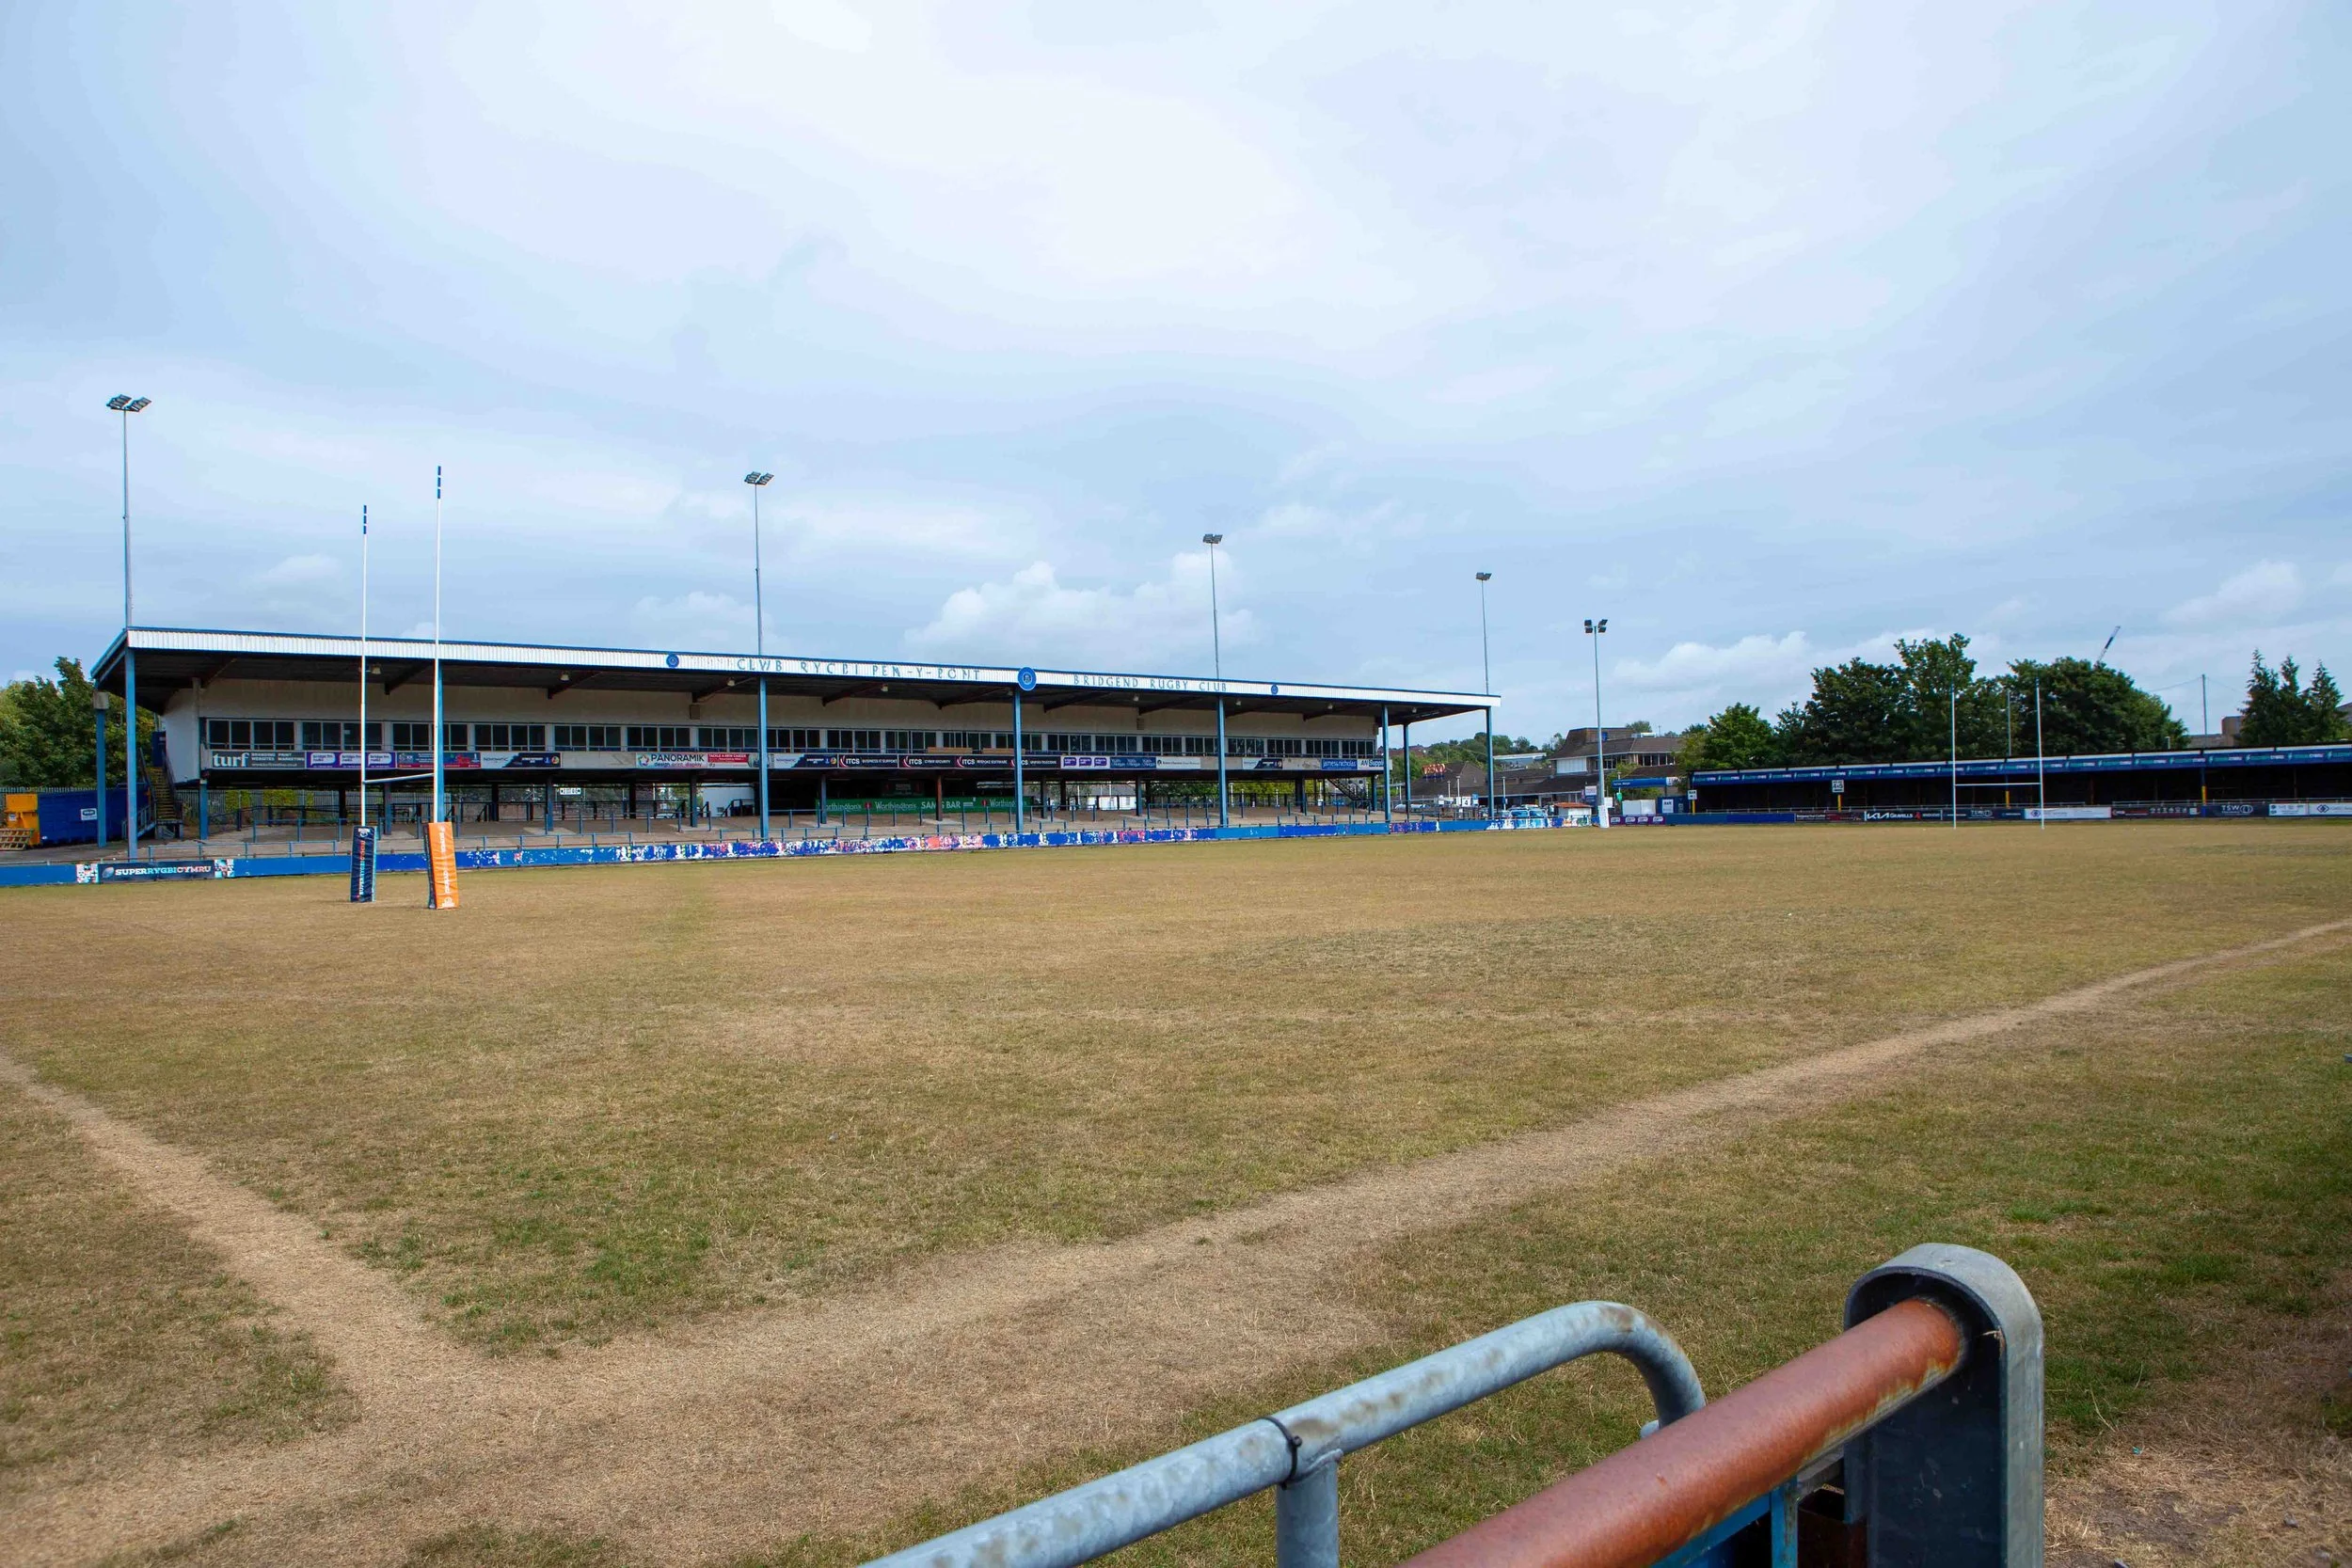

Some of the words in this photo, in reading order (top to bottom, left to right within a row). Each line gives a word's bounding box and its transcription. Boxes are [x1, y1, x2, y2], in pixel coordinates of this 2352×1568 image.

[737, 659, 783, 672] CLWB
[1073, 674, 1138, 688] BRIDGEND
[1150, 678, 1189, 690] RUGBY
[213, 752, 249, 768] turf
[651, 753, 705, 762] PANORAMIK
[946, 800, 961, 809] BAR
